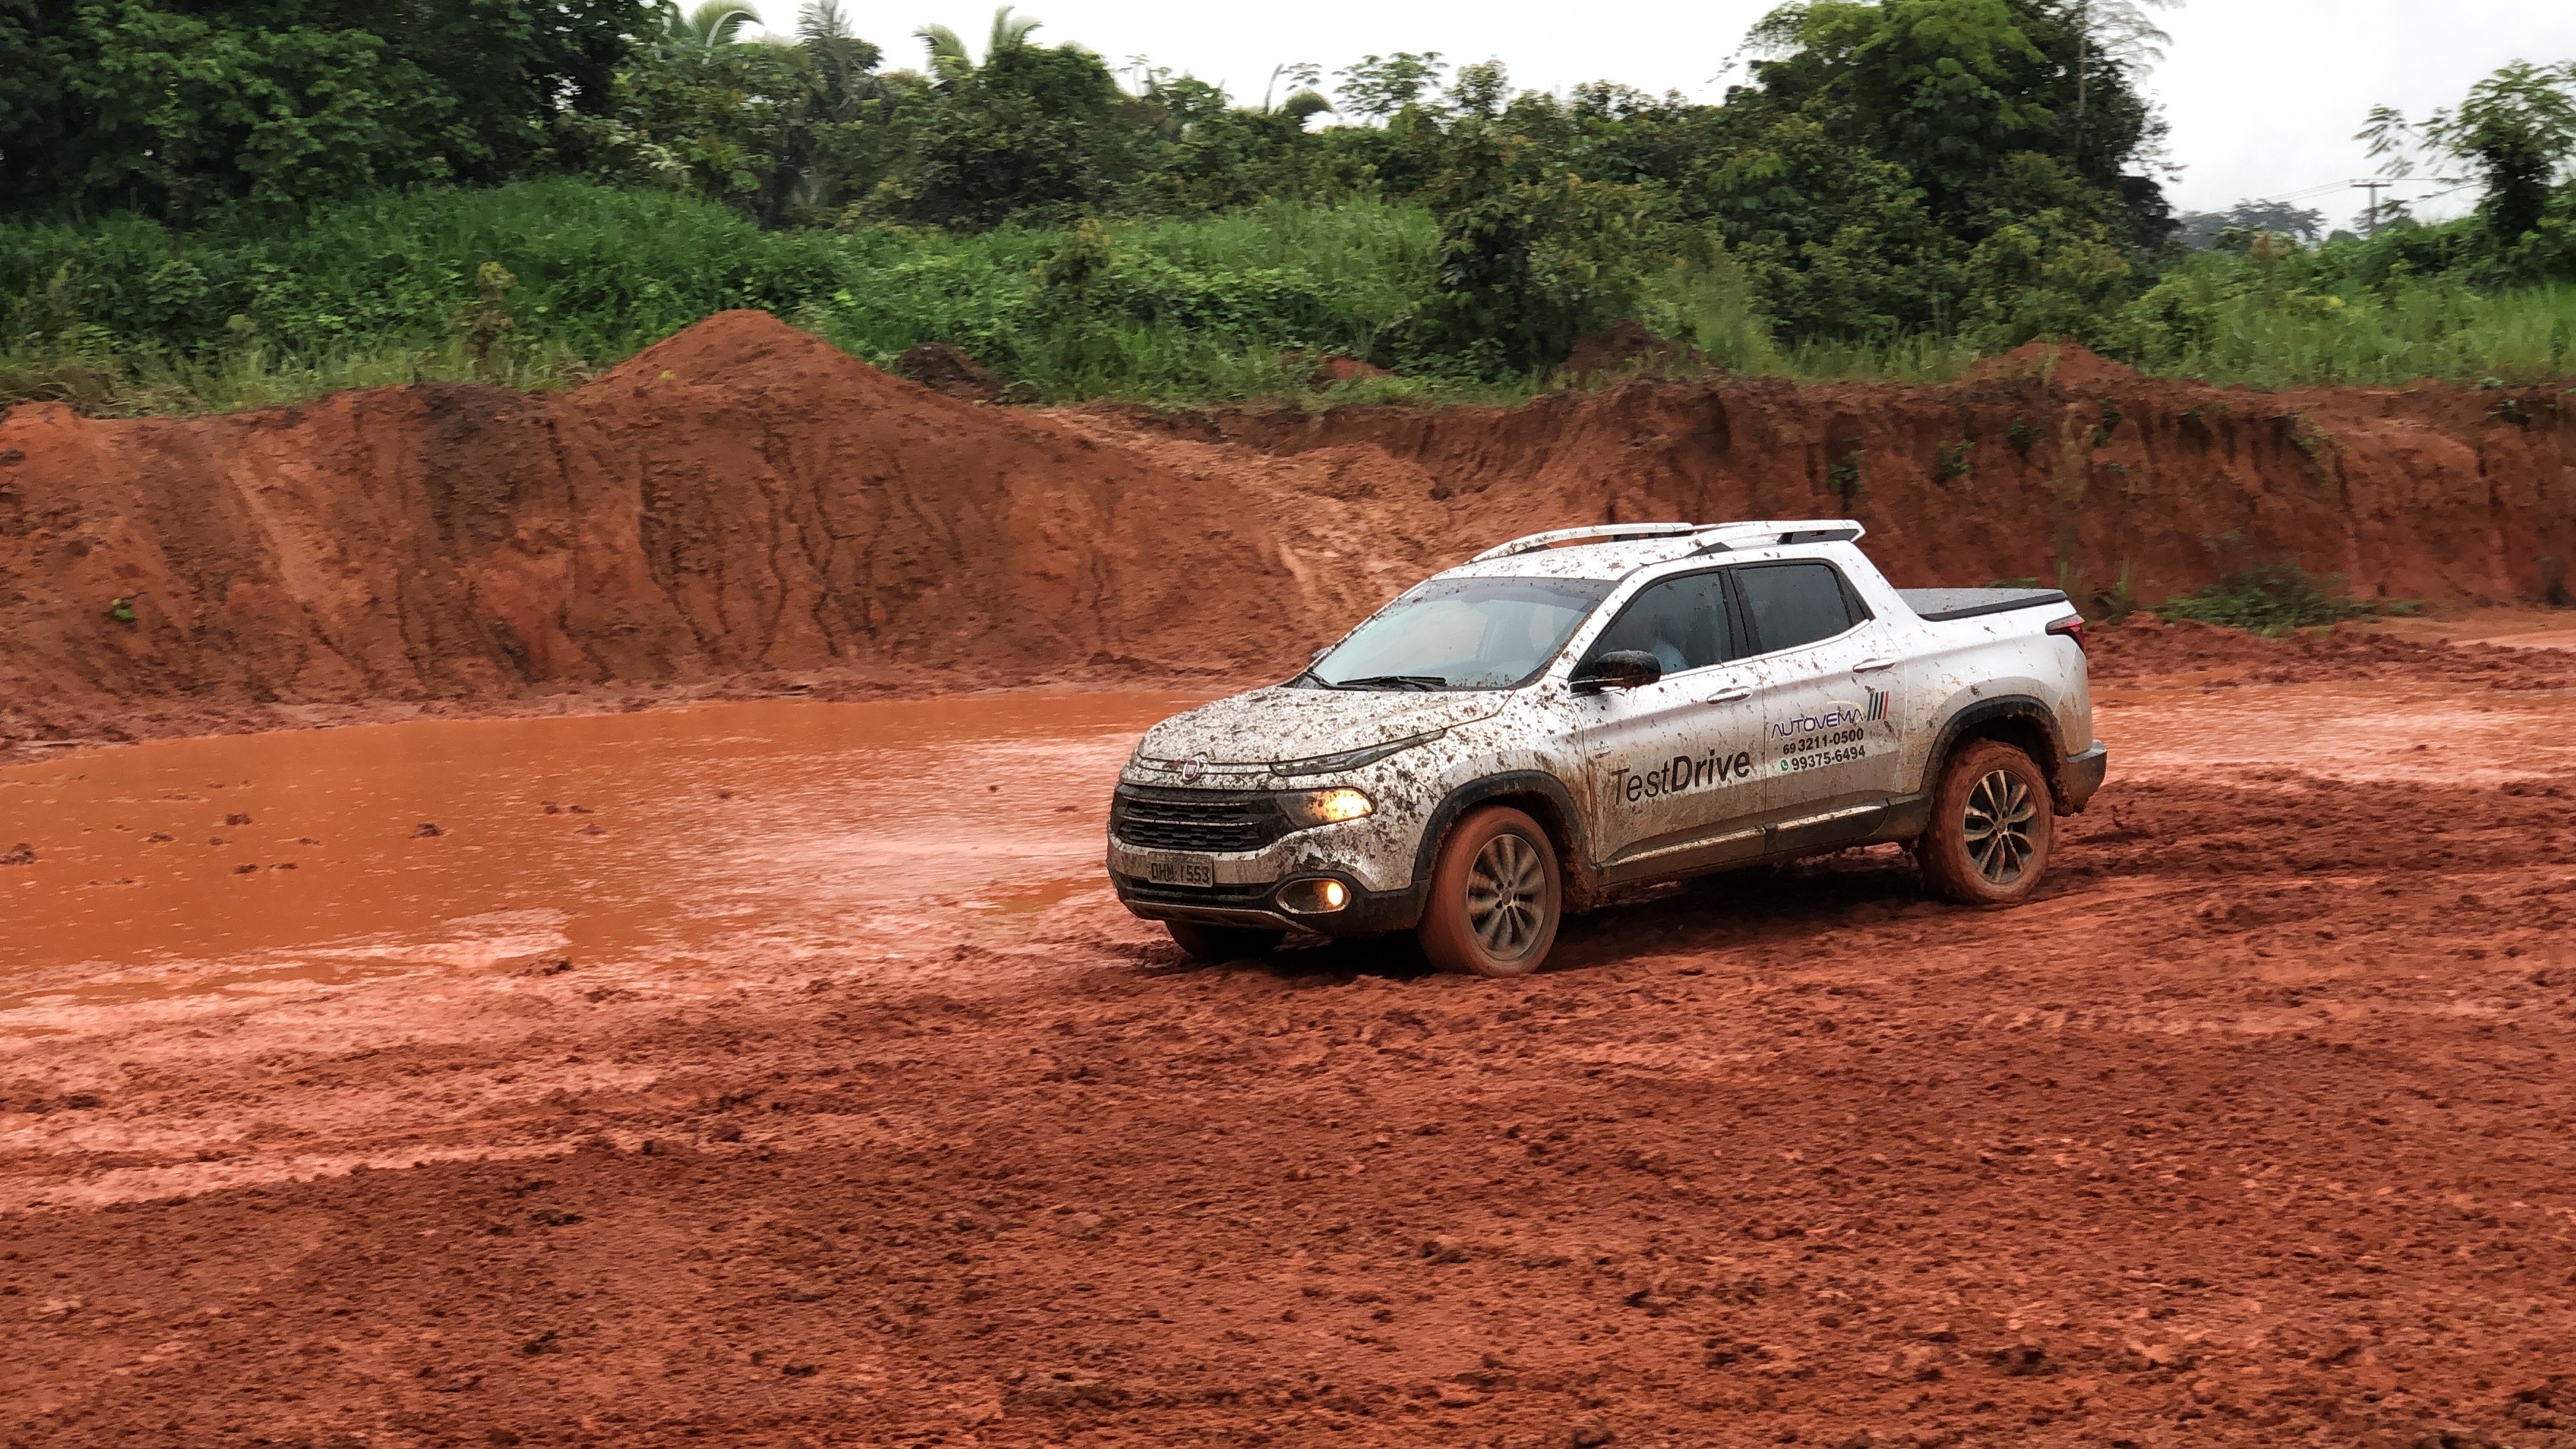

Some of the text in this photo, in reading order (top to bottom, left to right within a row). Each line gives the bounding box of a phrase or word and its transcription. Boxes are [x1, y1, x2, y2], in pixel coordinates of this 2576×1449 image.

[1771, 708, 1864, 739] AUTOVEMA
[1783, 727, 1864, 755] 69 3211-0500
[1791, 745, 1865, 771] 99375-6494
[1611, 749, 1751, 806] TestDrive
